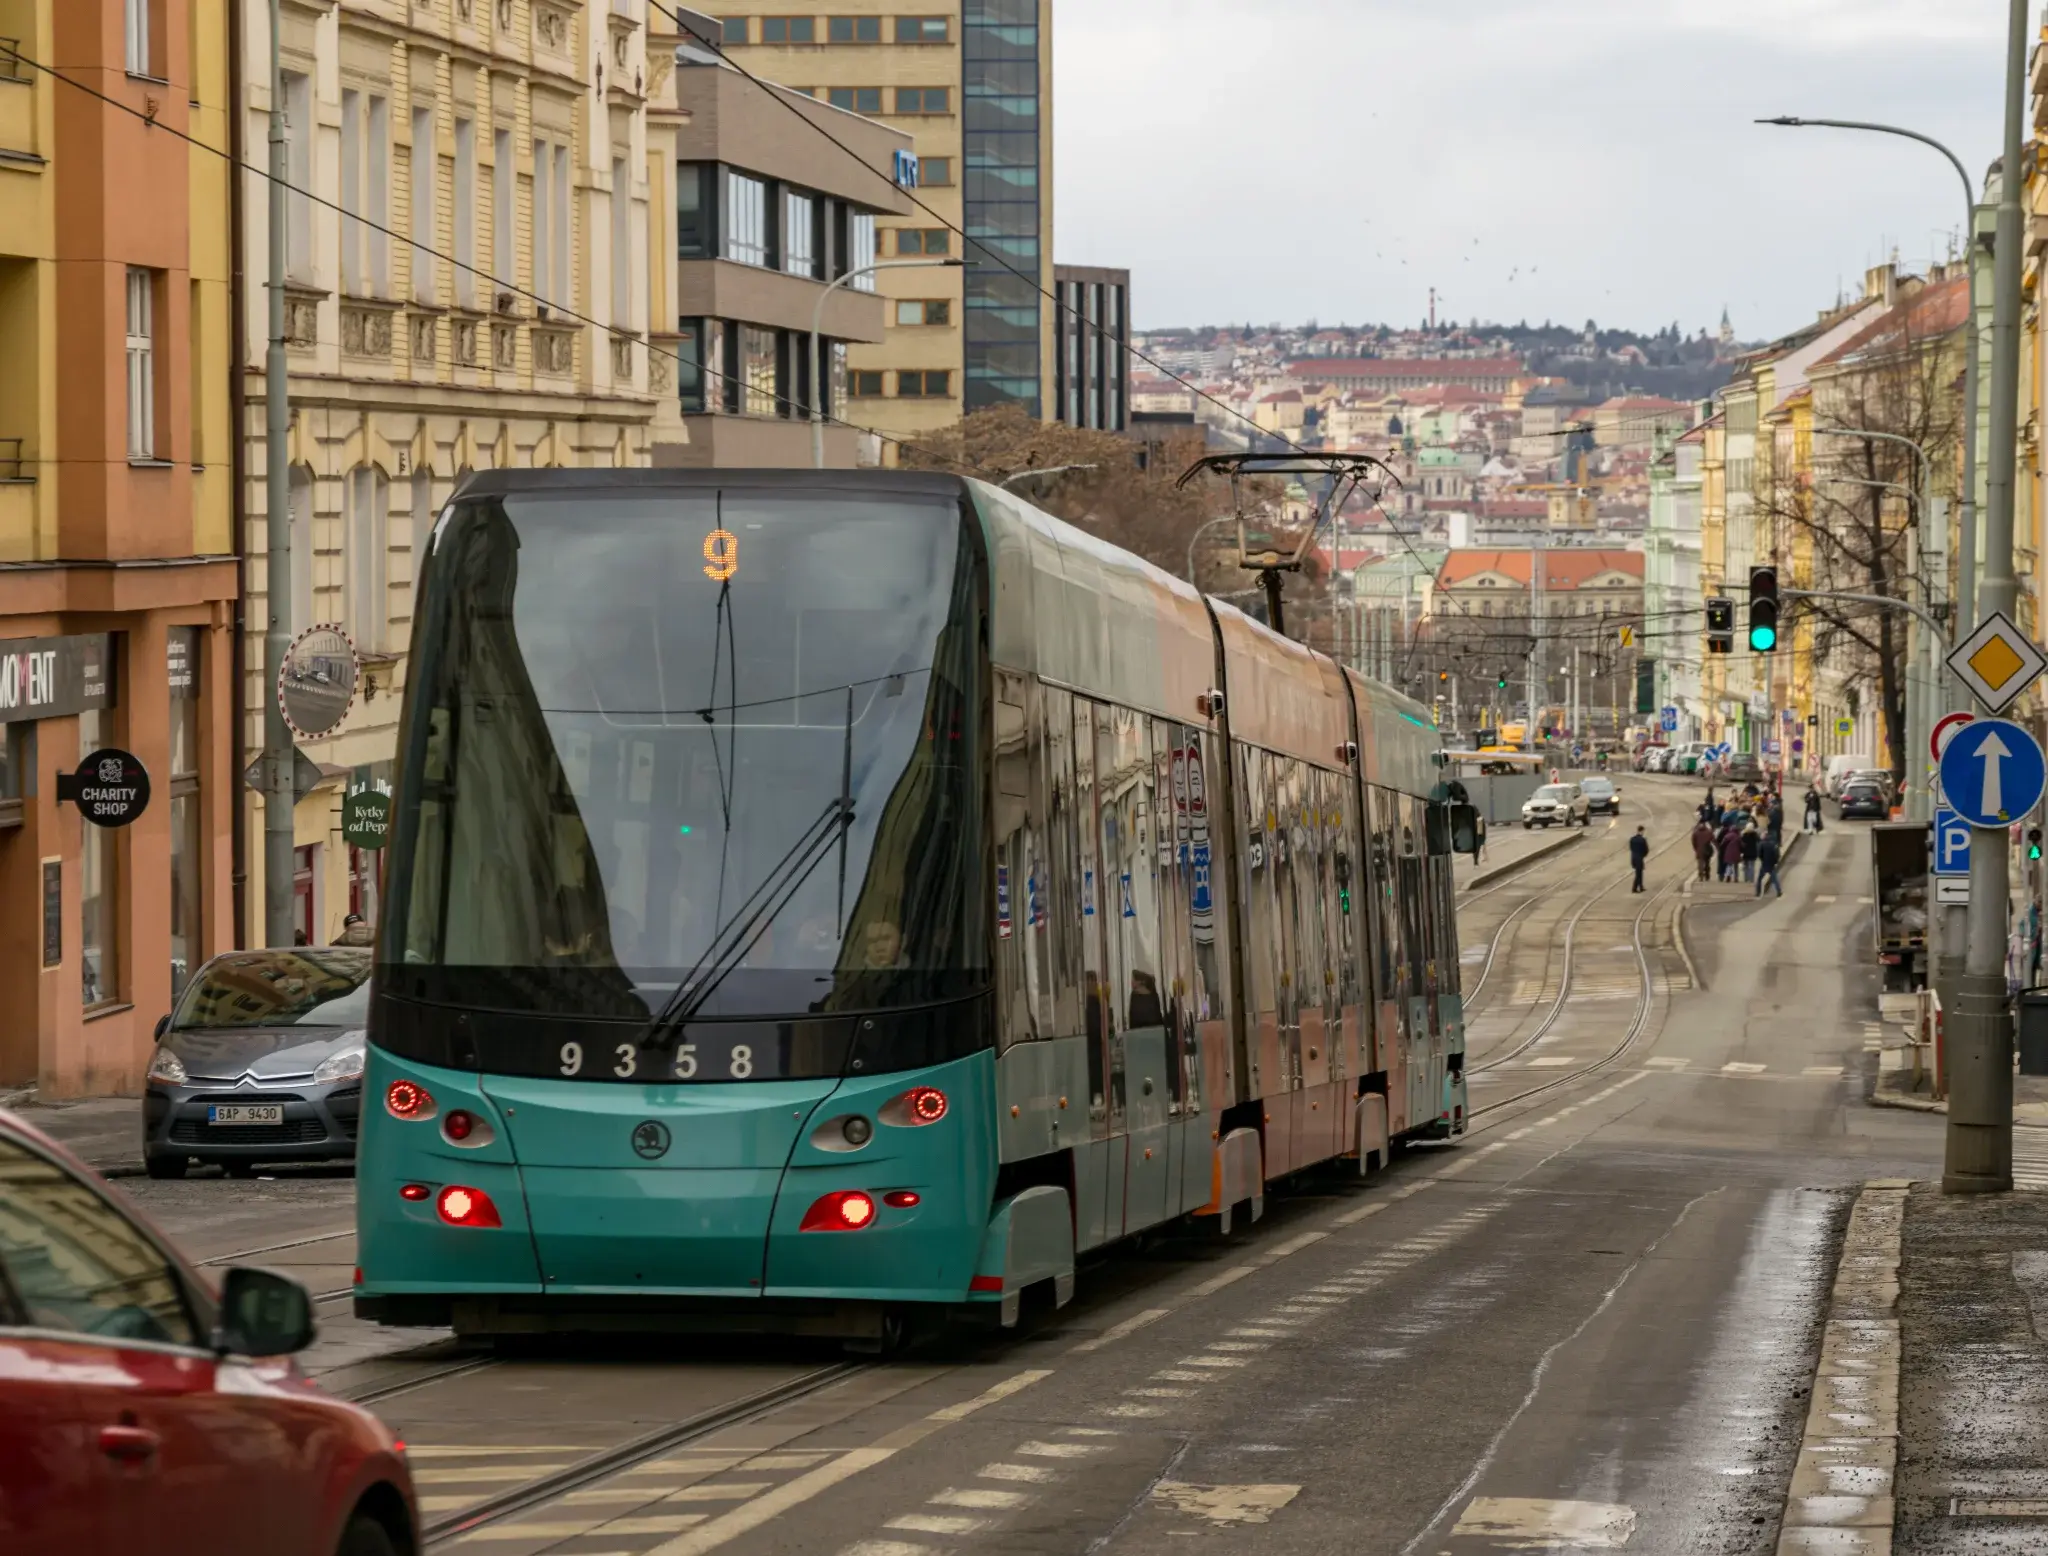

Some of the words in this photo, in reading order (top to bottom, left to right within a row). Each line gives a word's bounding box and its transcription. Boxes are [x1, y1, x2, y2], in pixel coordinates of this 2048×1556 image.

[703, 528, 737, 581] 9
[82, 788, 137, 801] CHARITY
[93, 802, 128, 815] SHOP
[355, 806, 385, 820] Kytky
[349, 820, 364, 832] od
[1944, 828, 1971, 865] P
[218, 1107, 239, 1120] 6AP
[248, 1107, 277, 1119] 9430
